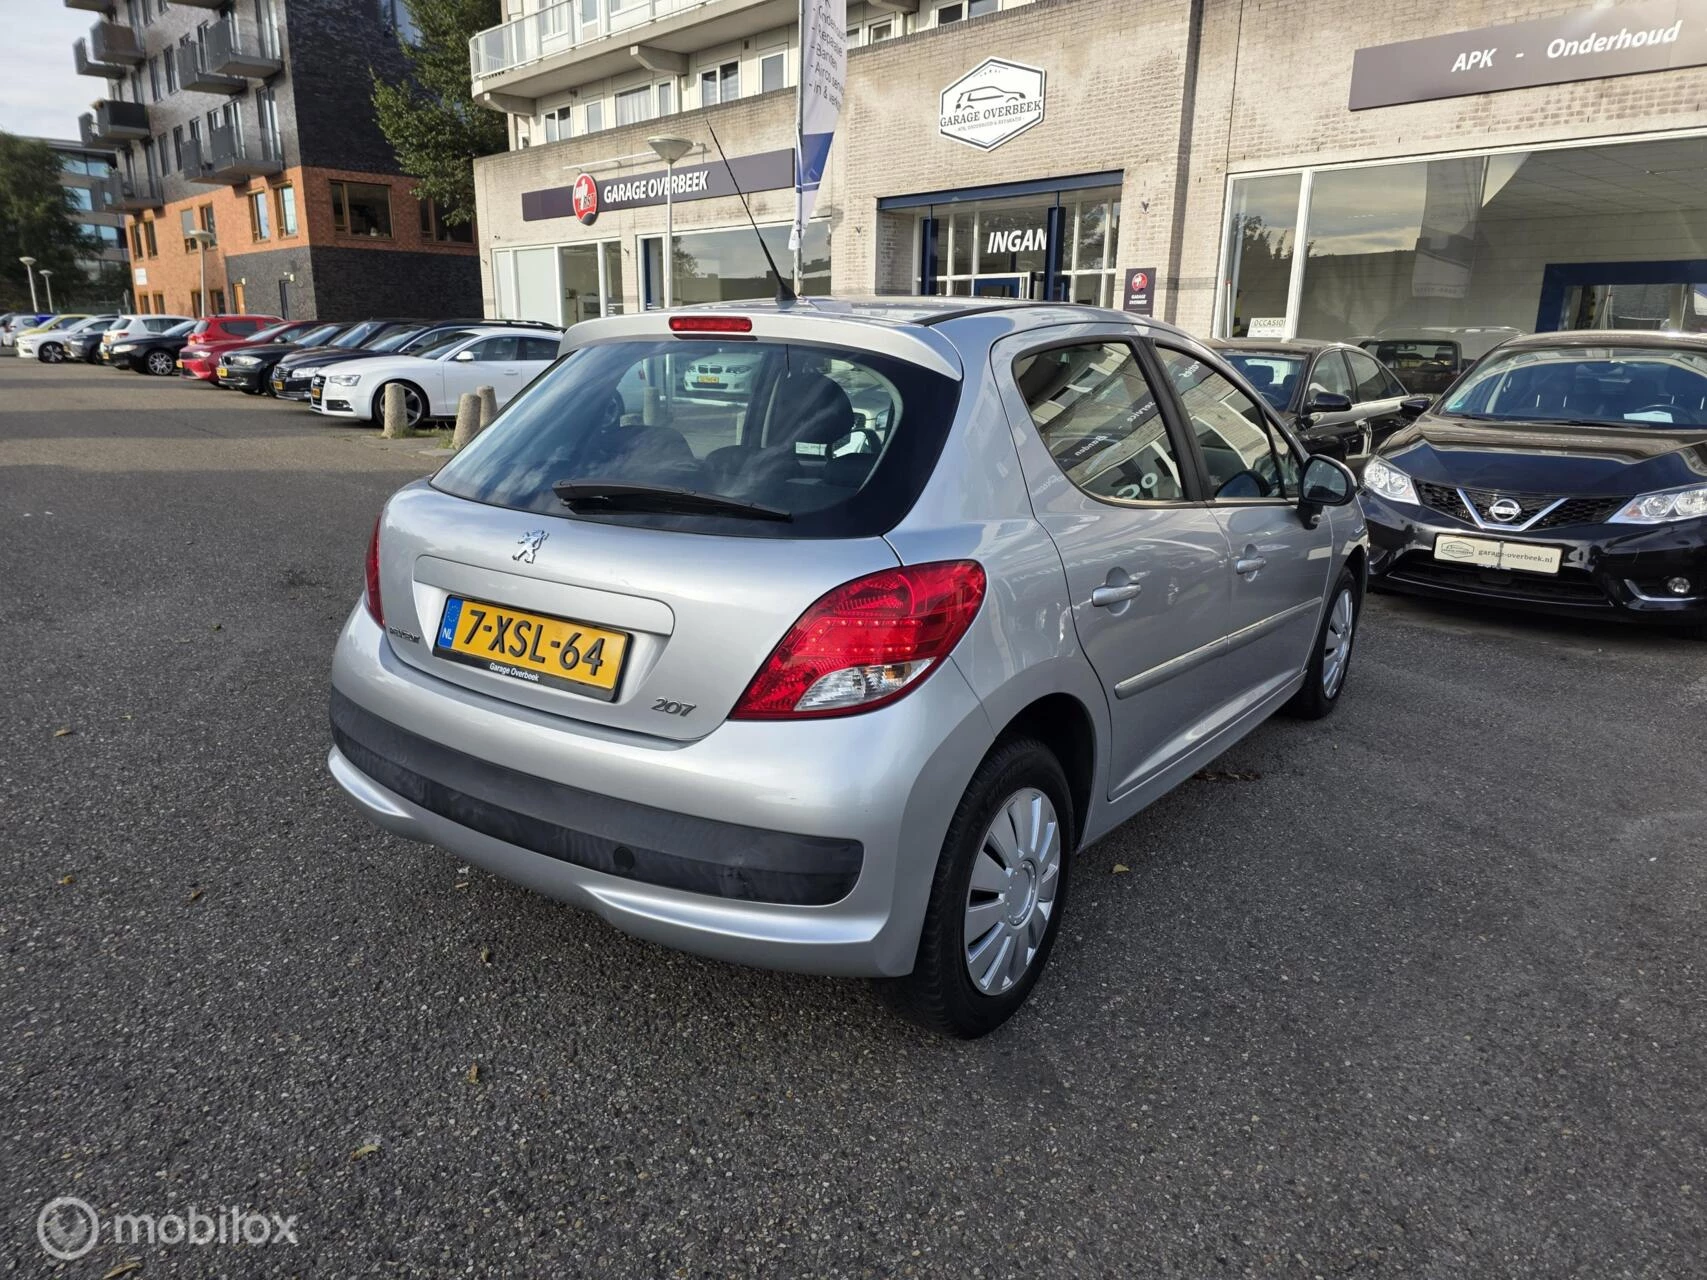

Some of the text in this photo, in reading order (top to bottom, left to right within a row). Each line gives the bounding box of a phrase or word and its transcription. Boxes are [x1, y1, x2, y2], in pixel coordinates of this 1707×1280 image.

[1451, 48, 1497, 72] APK
[1546, 20, 1683, 58] Onderhoud
[940, 100, 1042, 128] GARAGE OVERBEEK
[603, 180, 647, 203] GARAGE
[647, 170, 709, 198] OVERBEEK
[1478, 548, 1553, 563] garage-overbeek.nl
[442, 627, 453, 641] NL
[463, 609, 605, 677] 7-XSL-64
[489, 662, 540, 682] Garage Overbeek
[651, 697, 697, 717] 207
